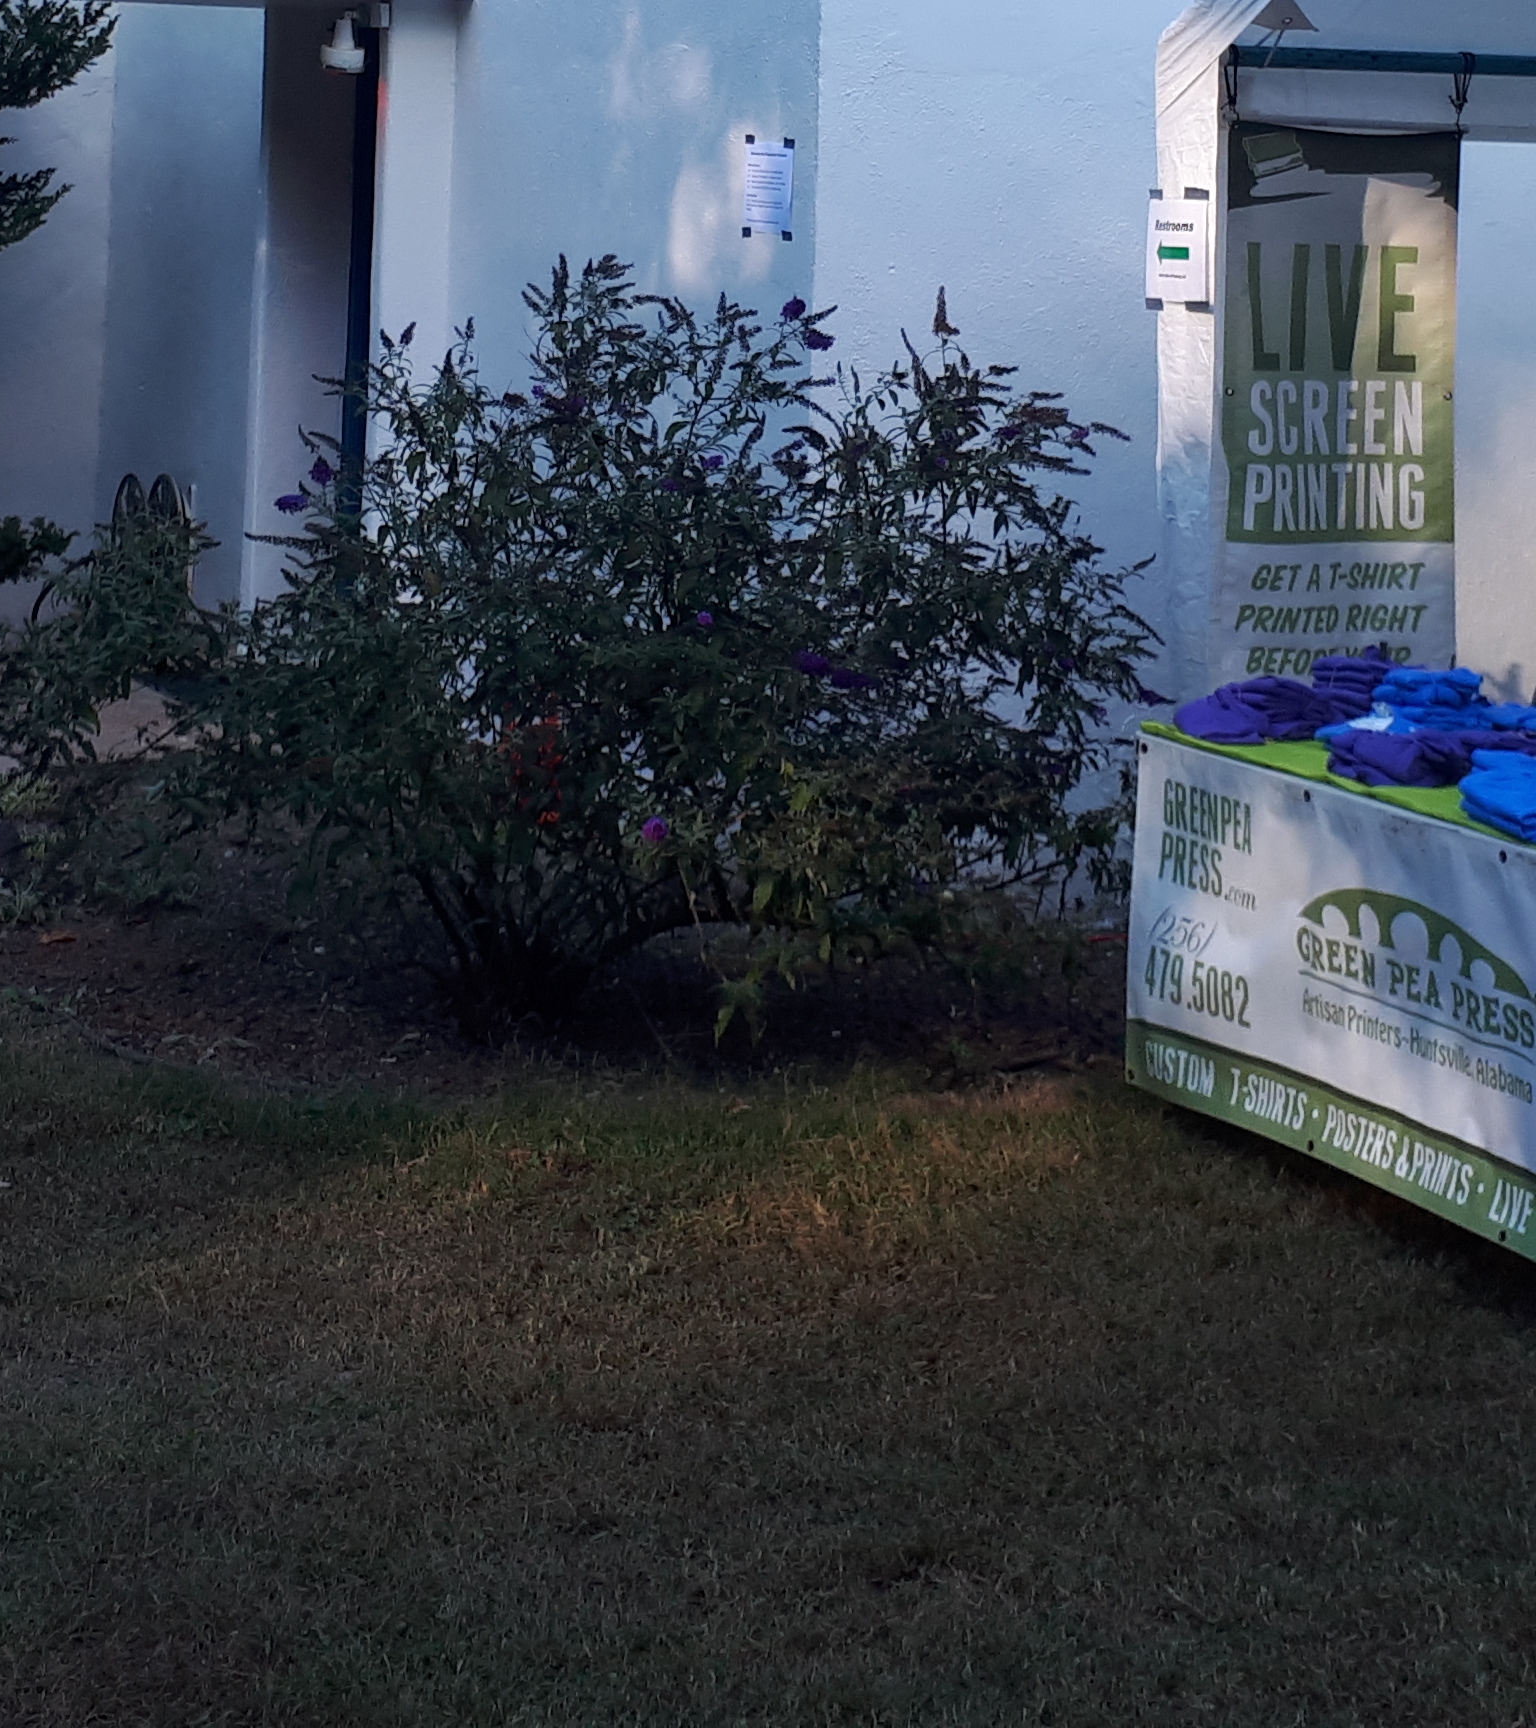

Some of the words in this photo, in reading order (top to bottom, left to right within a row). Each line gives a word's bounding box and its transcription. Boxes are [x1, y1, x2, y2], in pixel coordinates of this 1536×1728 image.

[1155, 219, 1194, 232] Restrooms
[1247, 242, 1418, 372] LIVE
[1247, 380, 1423, 456] SCREEN
[1243, 462, 1425, 531] PRINTING
[1250, 563, 1302, 592] GET
[1306, 562, 1321, 592] A
[1329, 561, 1426, 591] T-SHIRT
[1234, 604, 1339, 633] PRINTED
[1345, 603, 1428, 633] RIGHT
[1164, 778, 1252, 856] GREENPEA
[1149, 904, 1218, 957] (256)
[1145, 945, 1251, 1029] 479.5082
[1297, 927, 1375, 988] GREEN
[1386, 958, 1443, 1010] PEA
[1451, 981, 1535, 1048] PRESS
[1303, 987, 1344, 1026] Artisan
[1476, 1057, 1533, 1104] Alabama
[1145, 1040, 1214, 1097] CUSTOM
[1230, 1068, 1307, 1130] T-SHIRTS
[1321, 1104, 1398, 1169] POSTERS
[1407, 1141, 1474, 1205] PRINTS
[1488, 1178, 1534, 1234] LIVE
